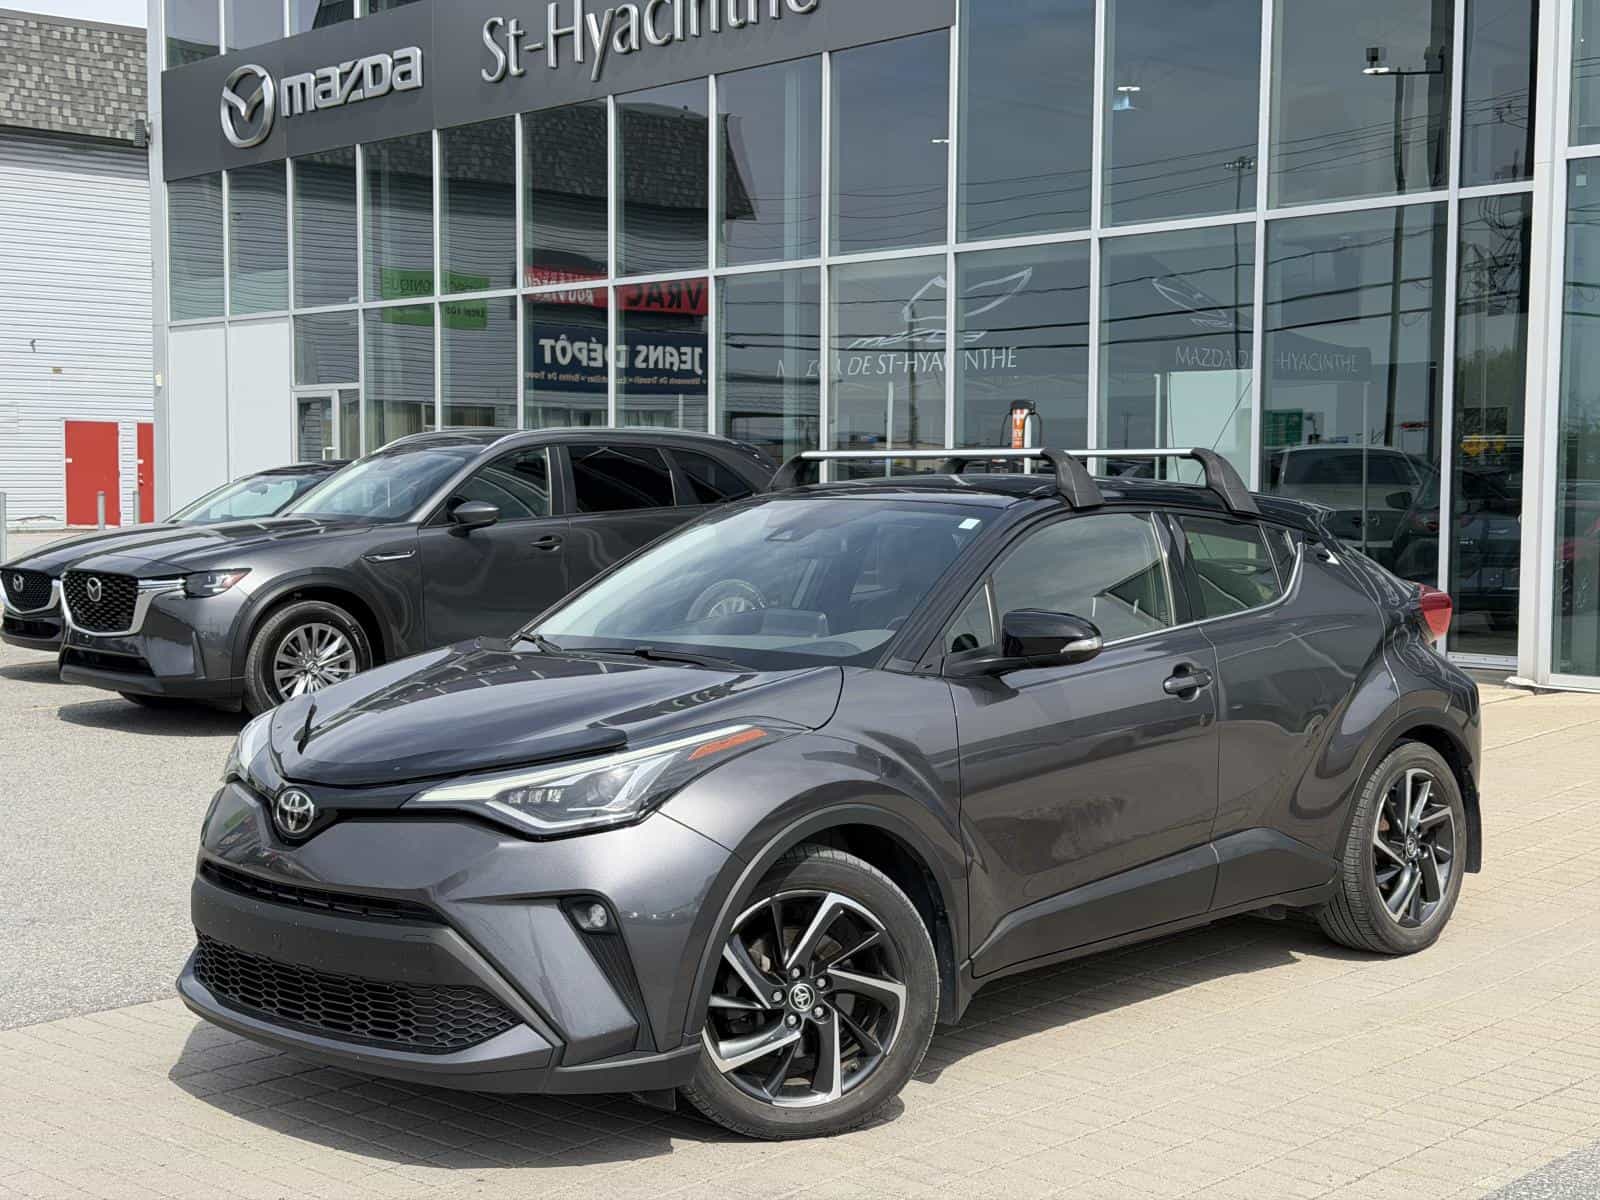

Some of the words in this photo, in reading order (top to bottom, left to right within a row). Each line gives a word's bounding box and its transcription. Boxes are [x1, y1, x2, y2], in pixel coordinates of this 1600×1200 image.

[847, 356, 872, 376] DE
[876, 347, 1017, 375] ST-HYANTHE
[1175, 346, 1232, 369] MAZDA
